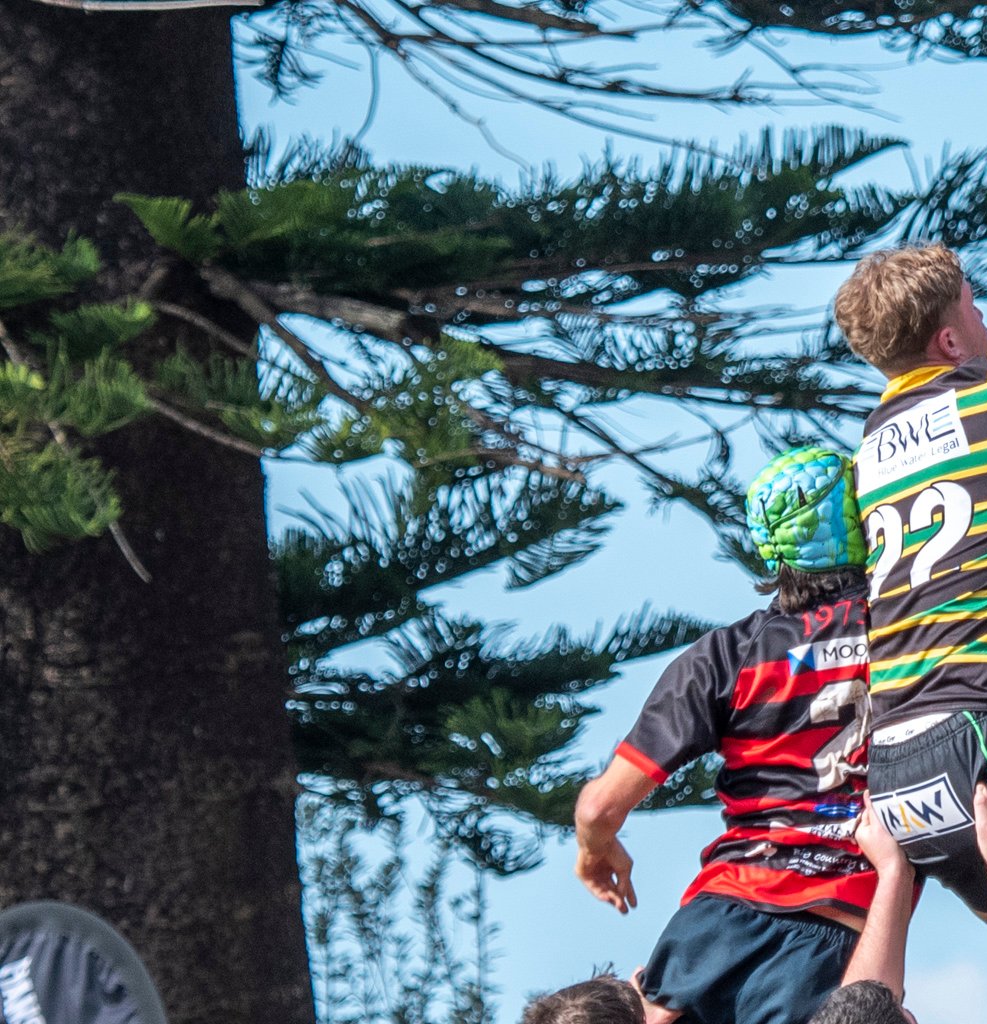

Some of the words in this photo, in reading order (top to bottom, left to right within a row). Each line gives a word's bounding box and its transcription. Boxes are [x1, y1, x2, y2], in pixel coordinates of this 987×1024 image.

[931, 437, 960, 455] Legal
[866, 480, 973, 599] 22
[822, 643, 868, 662] MOO
